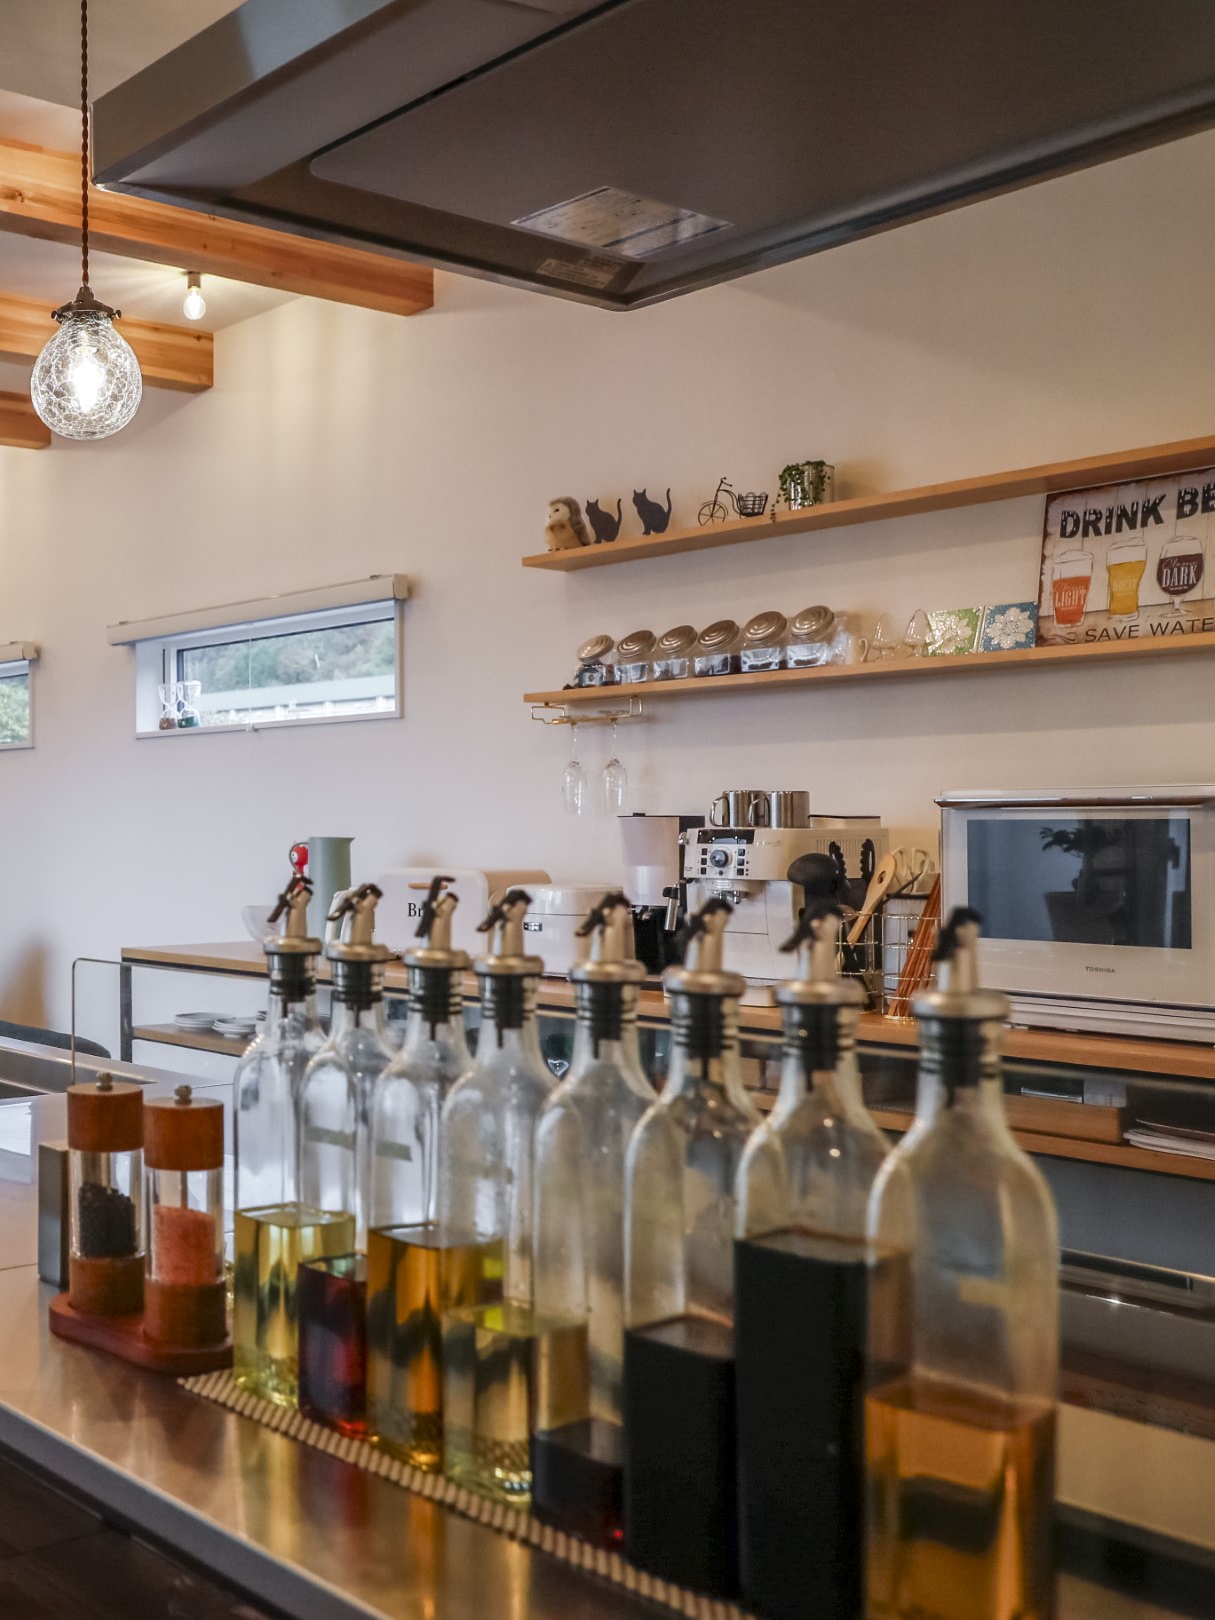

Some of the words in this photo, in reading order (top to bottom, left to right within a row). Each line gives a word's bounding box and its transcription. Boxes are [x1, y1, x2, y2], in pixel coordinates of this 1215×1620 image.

[1059, 493, 1166, 538] DRINK
[1162, 565, 1197, 587] DARK
[1055, 589, 1086, 607] LIGHT
[1085, 624, 1140, 642] SAVE
[1150, 617, 1215, 636] WATE
[407, 902, 423, 917] Br
